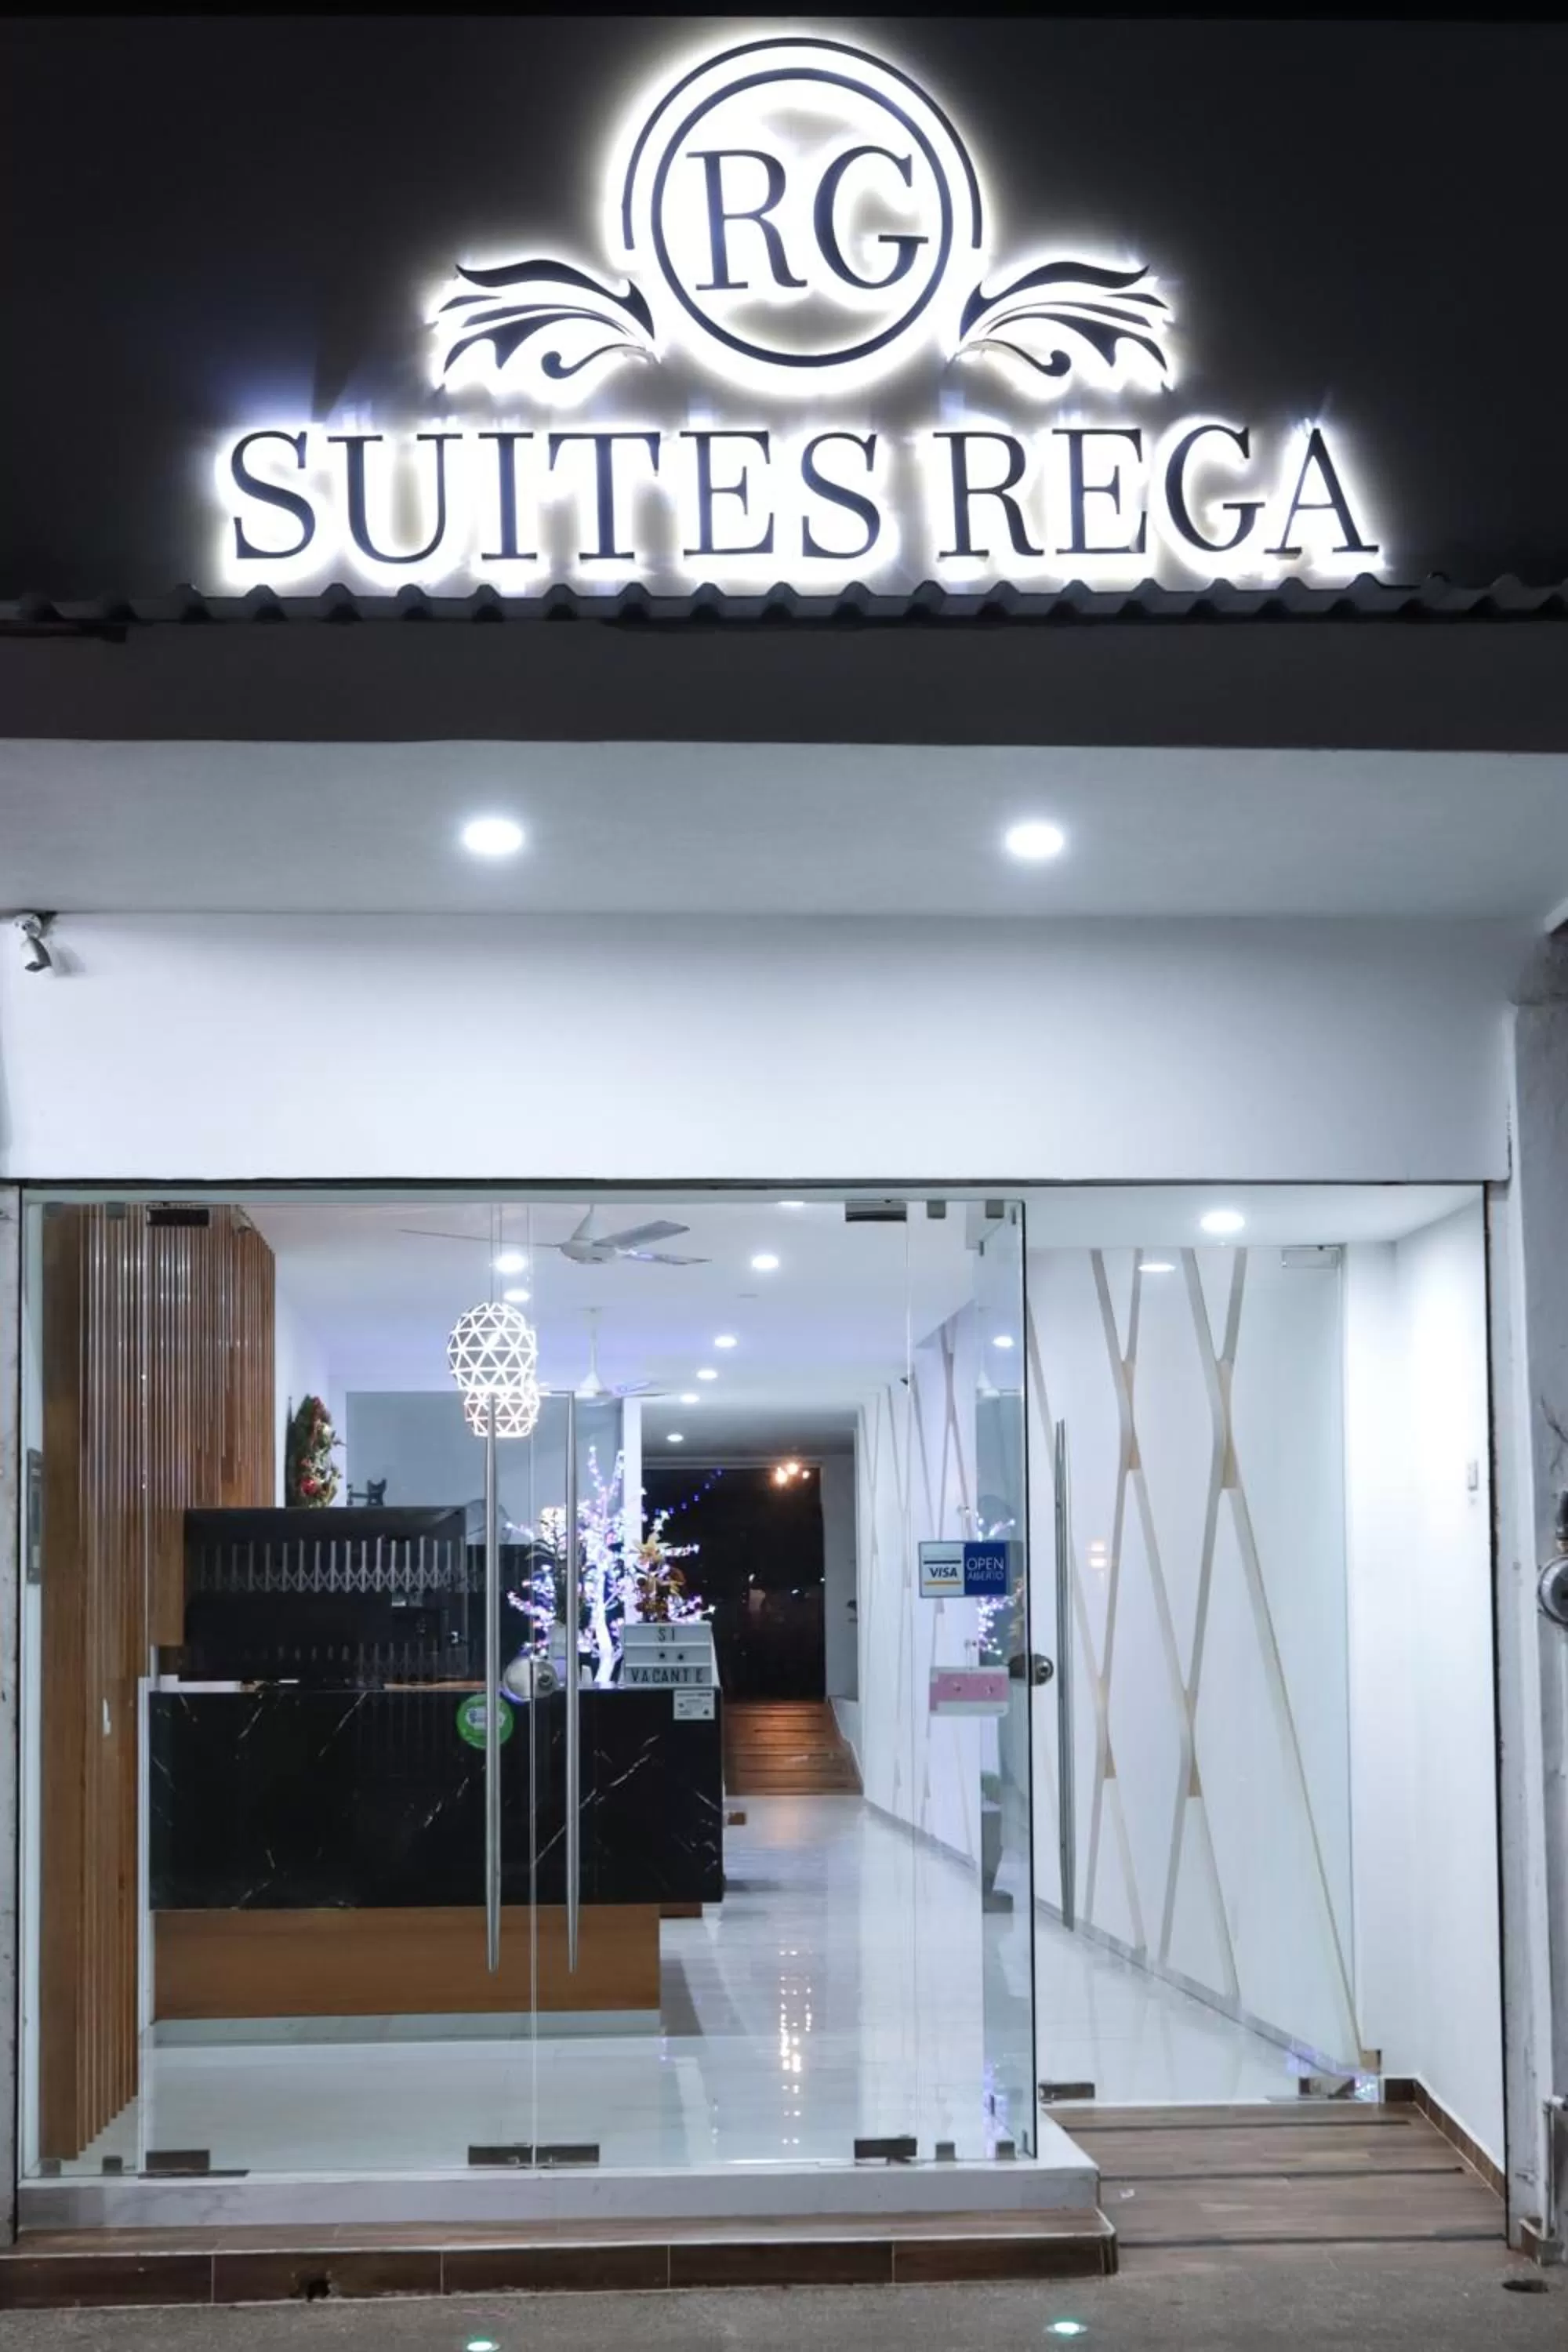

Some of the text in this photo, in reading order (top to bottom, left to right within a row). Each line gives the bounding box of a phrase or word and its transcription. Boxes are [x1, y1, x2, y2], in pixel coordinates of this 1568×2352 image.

[687, 145, 930, 292] RG
[230, 426, 1378, 563] SUITES REGA
[967, 1557, 1004, 1570] OPEN
[929, 1567, 957, 1578] VISA
[658, 1627, 676, 1642] SI
